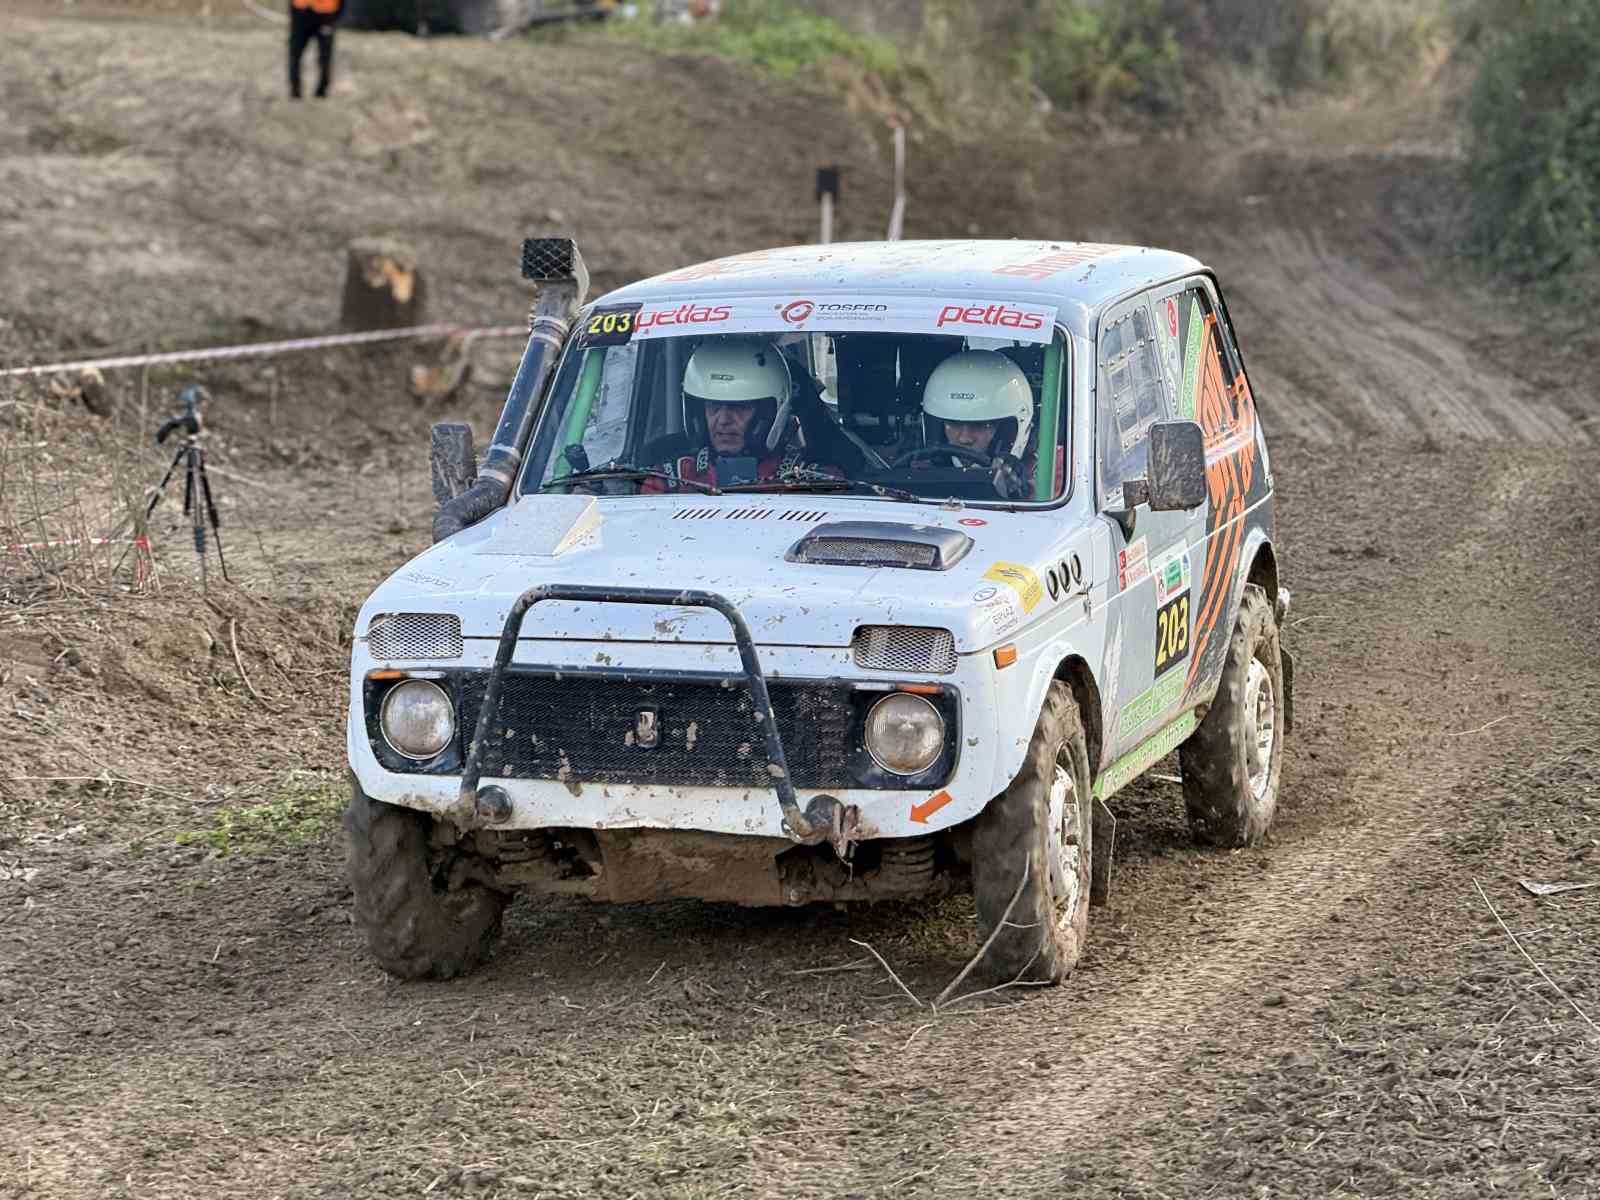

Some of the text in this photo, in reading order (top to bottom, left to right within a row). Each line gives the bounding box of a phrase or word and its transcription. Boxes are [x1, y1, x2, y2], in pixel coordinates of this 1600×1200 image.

[587, 312, 631, 334] 203
[937, 304, 1045, 329] petlas
[1156, 596, 1188, 667] 203
